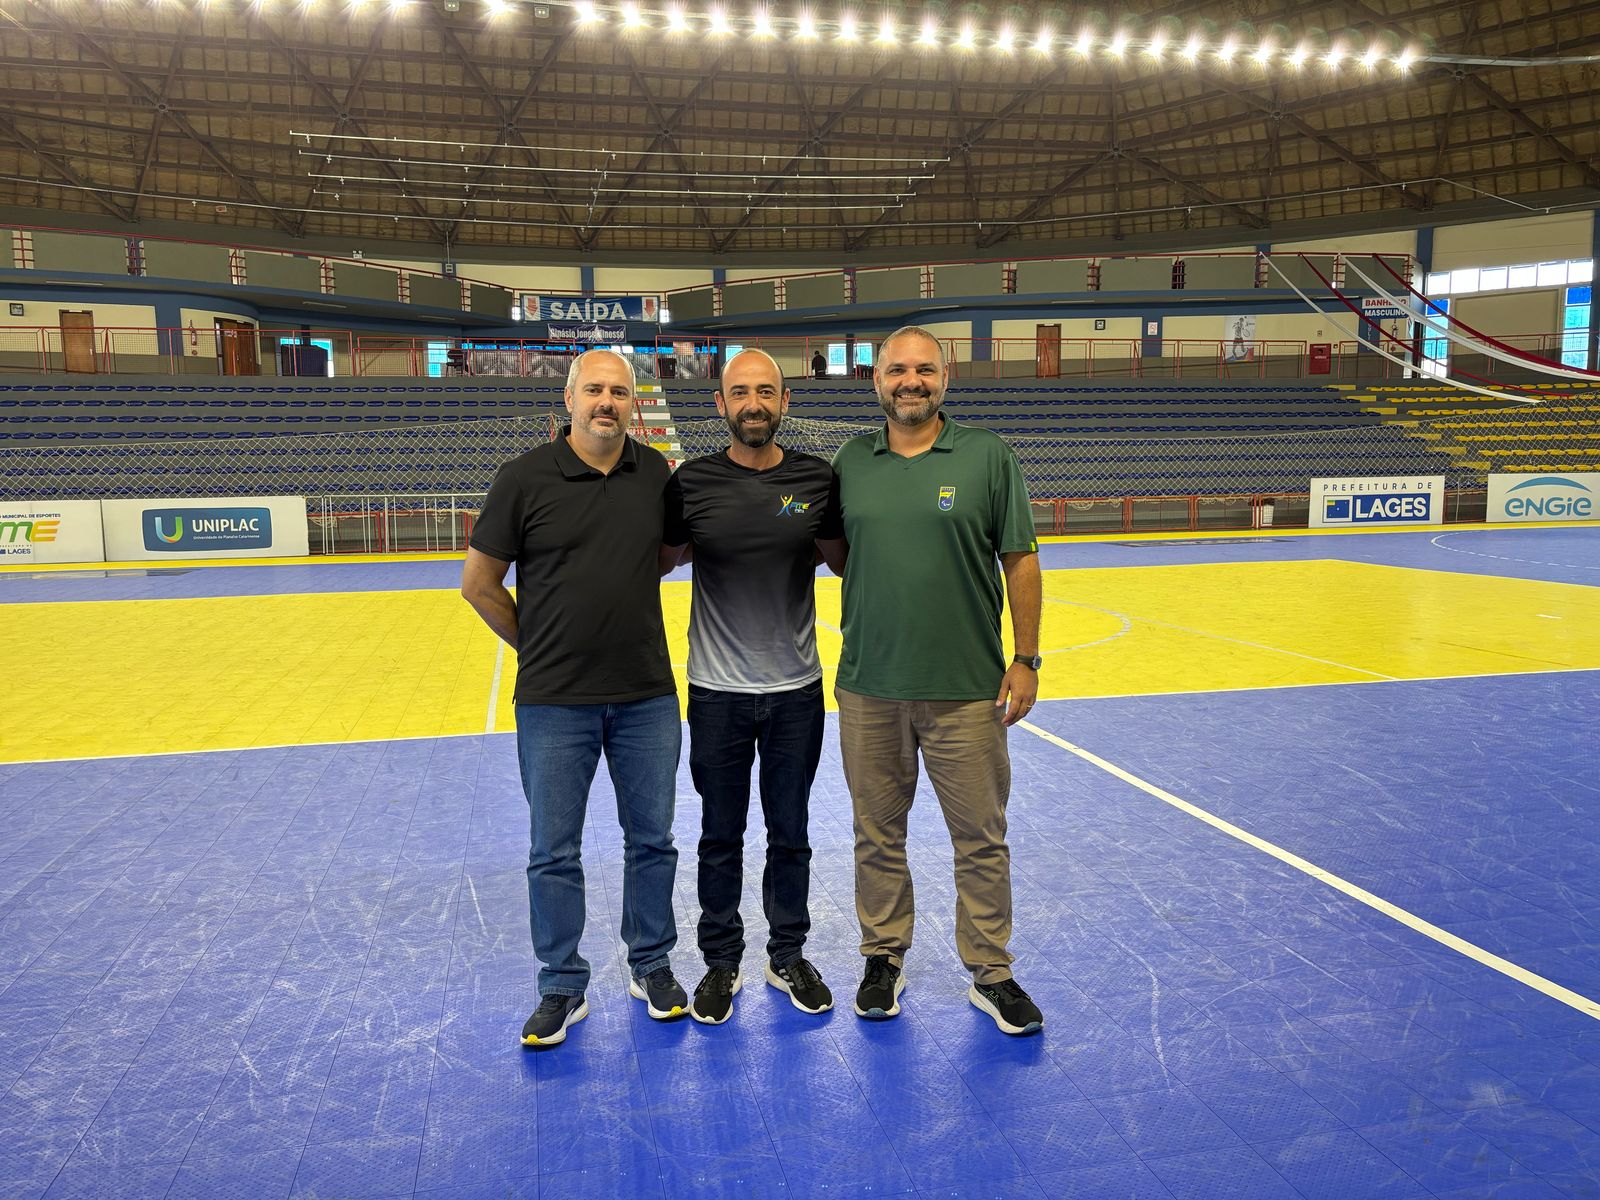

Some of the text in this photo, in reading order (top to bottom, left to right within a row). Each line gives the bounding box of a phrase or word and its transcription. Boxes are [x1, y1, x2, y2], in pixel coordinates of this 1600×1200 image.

[550, 298, 627, 321] SAÍDA
[1323, 483, 1407, 491] PREFEITURA
[1355, 498, 1427, 518] LAGES
[192, 518, 260, 533] UNIPLAC
